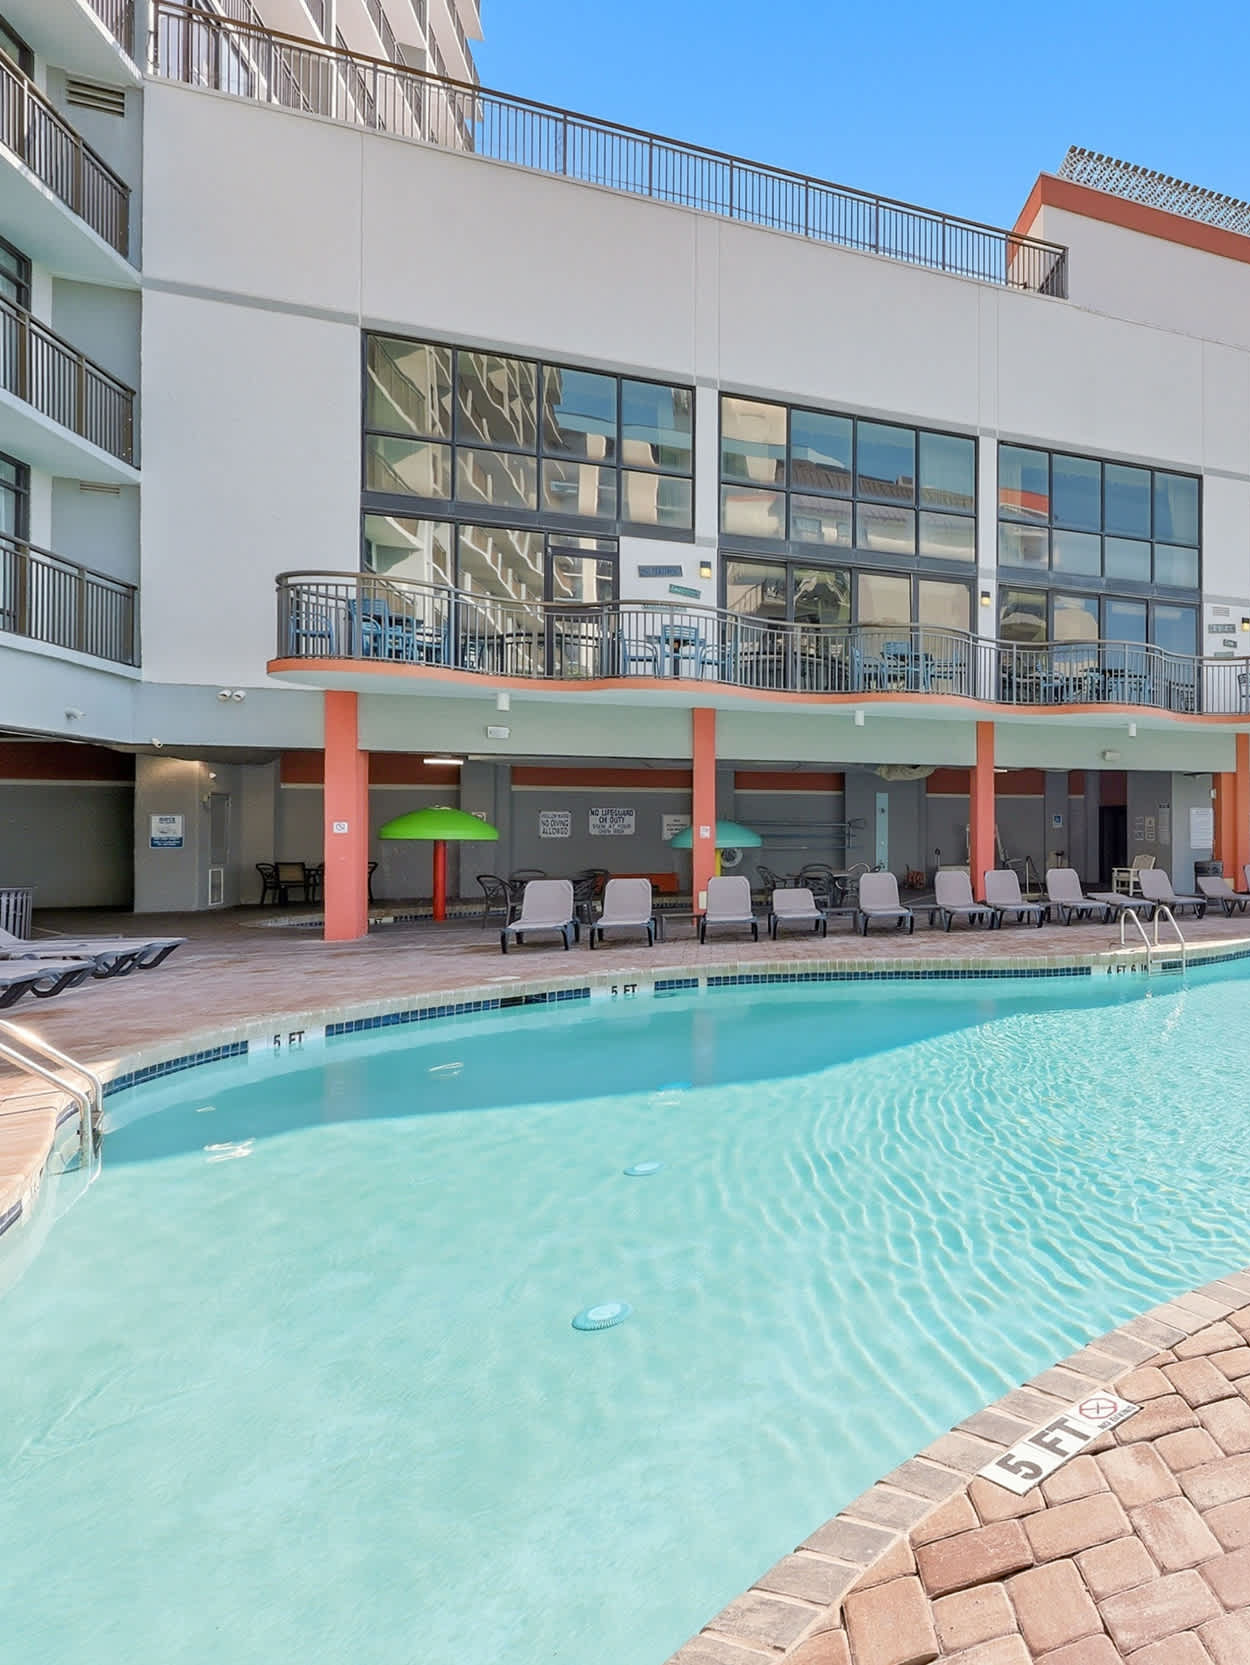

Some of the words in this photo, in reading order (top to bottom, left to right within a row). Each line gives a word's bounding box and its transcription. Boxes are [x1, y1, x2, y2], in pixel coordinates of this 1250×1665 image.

[591, 809, 599, 817] NO
[601, 809, 634, 817] LIFEGUARD
[610, 816, 625, 824] DUTY
[1116, 965, 1127, 974] FT
[611, 985, 618, 996] 5
[623, 984, 638, 994] FT
[274, 1034, 281, 1047] 5
[289, 1031, 305, 1045] FT
[1096, 1422, 1110, 1430] NO
[995, 1453, 1044, 1480] 5
[1028, 1416, 1092, 1458] FT
